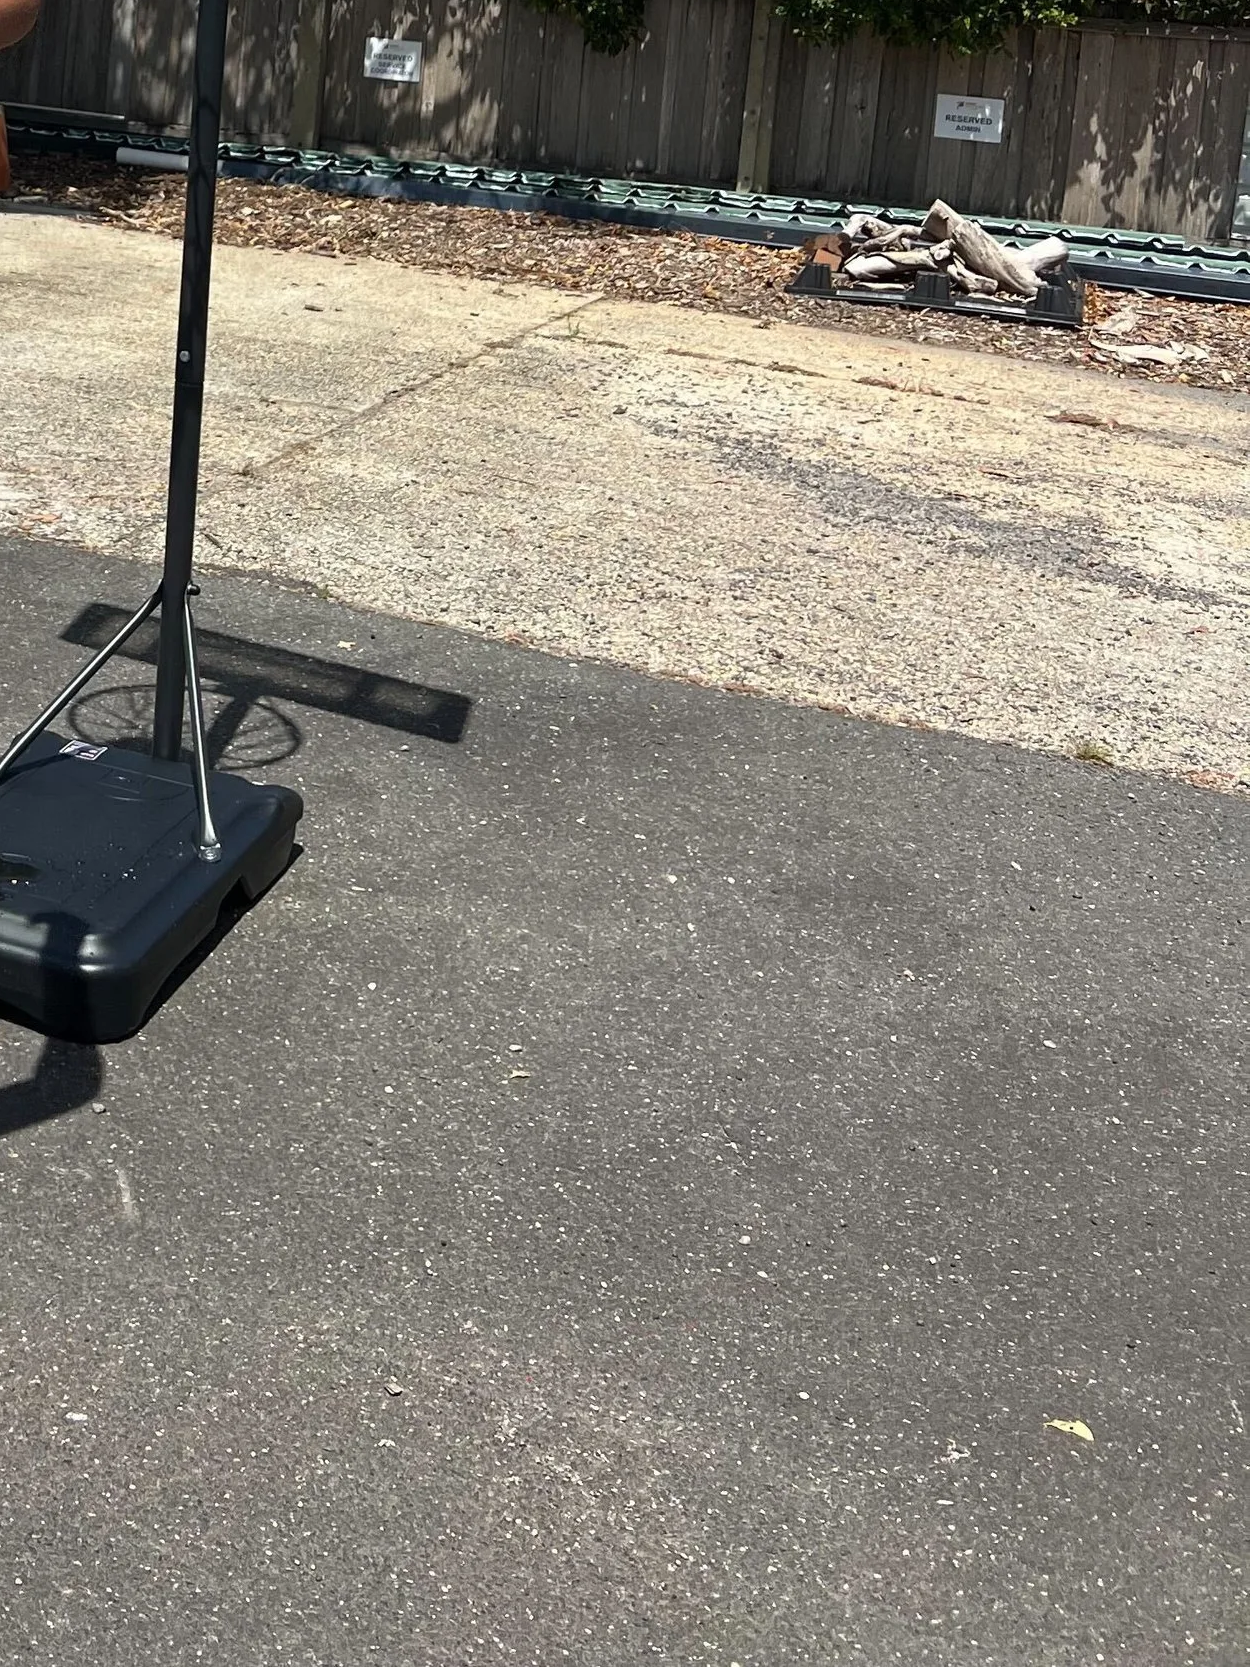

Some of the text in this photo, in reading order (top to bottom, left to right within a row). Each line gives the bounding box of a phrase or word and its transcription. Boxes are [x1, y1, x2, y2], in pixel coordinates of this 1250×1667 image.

[373, 53, 413, 62] RESERVED
[945, 114, 992, 126] RESERVED
[955, 124, 981, 133] ADMIN
